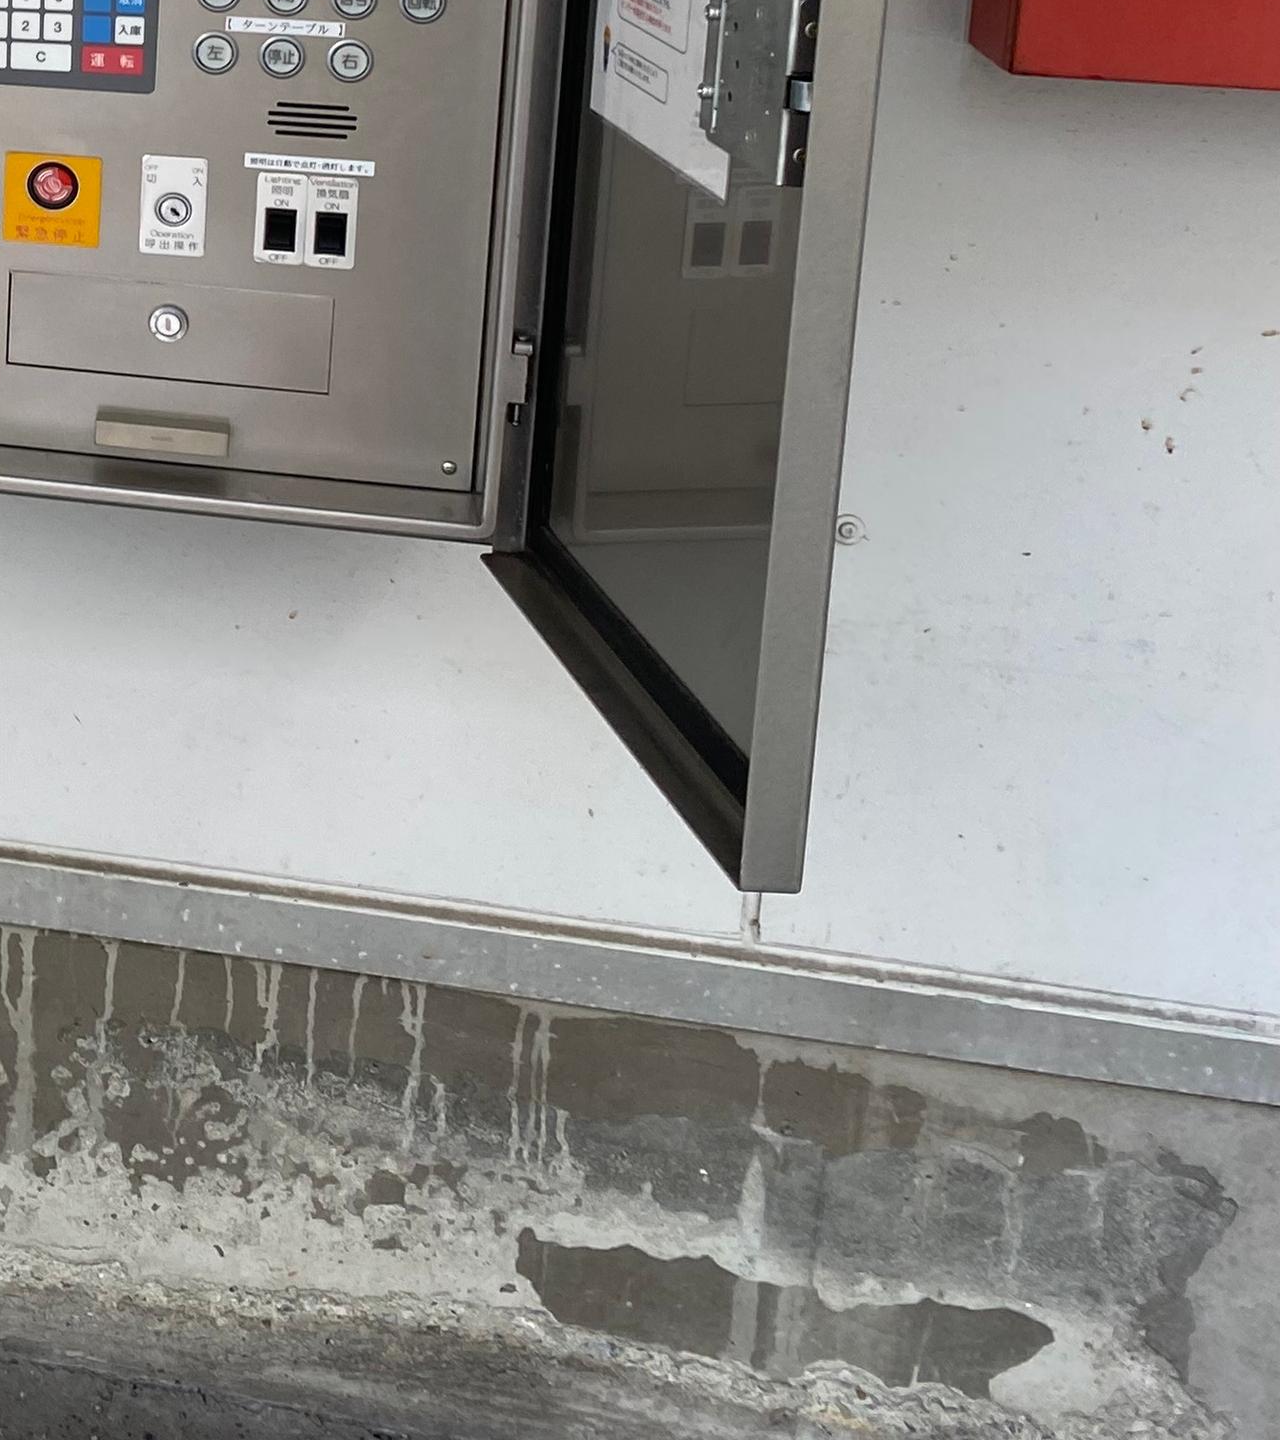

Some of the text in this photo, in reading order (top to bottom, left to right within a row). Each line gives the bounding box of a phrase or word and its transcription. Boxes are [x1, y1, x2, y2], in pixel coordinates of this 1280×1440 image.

[21, 20, 30, 32] 2
[53, 21, 62, 33] 3
[118, 24, 142, 36] 入庫
[35, 50, 47, 63] C
[206, 44, 359, 71] 左 停止 右
[144, 164, 204, 175] OFF ON
[192, 176, 203, 187] 入
[309, 178, 358, 190] Ventilation
[271, 185, 350, 200] 照明 換気扇
[273, 198, 341, 211] ON ON
[15, 225, 85, 244] 緊急停止
[149, 229, 195, 240] Operation
[144, 237, 199, 252] 呼出操作
[268, 253, 338, 266] OFF OFF
